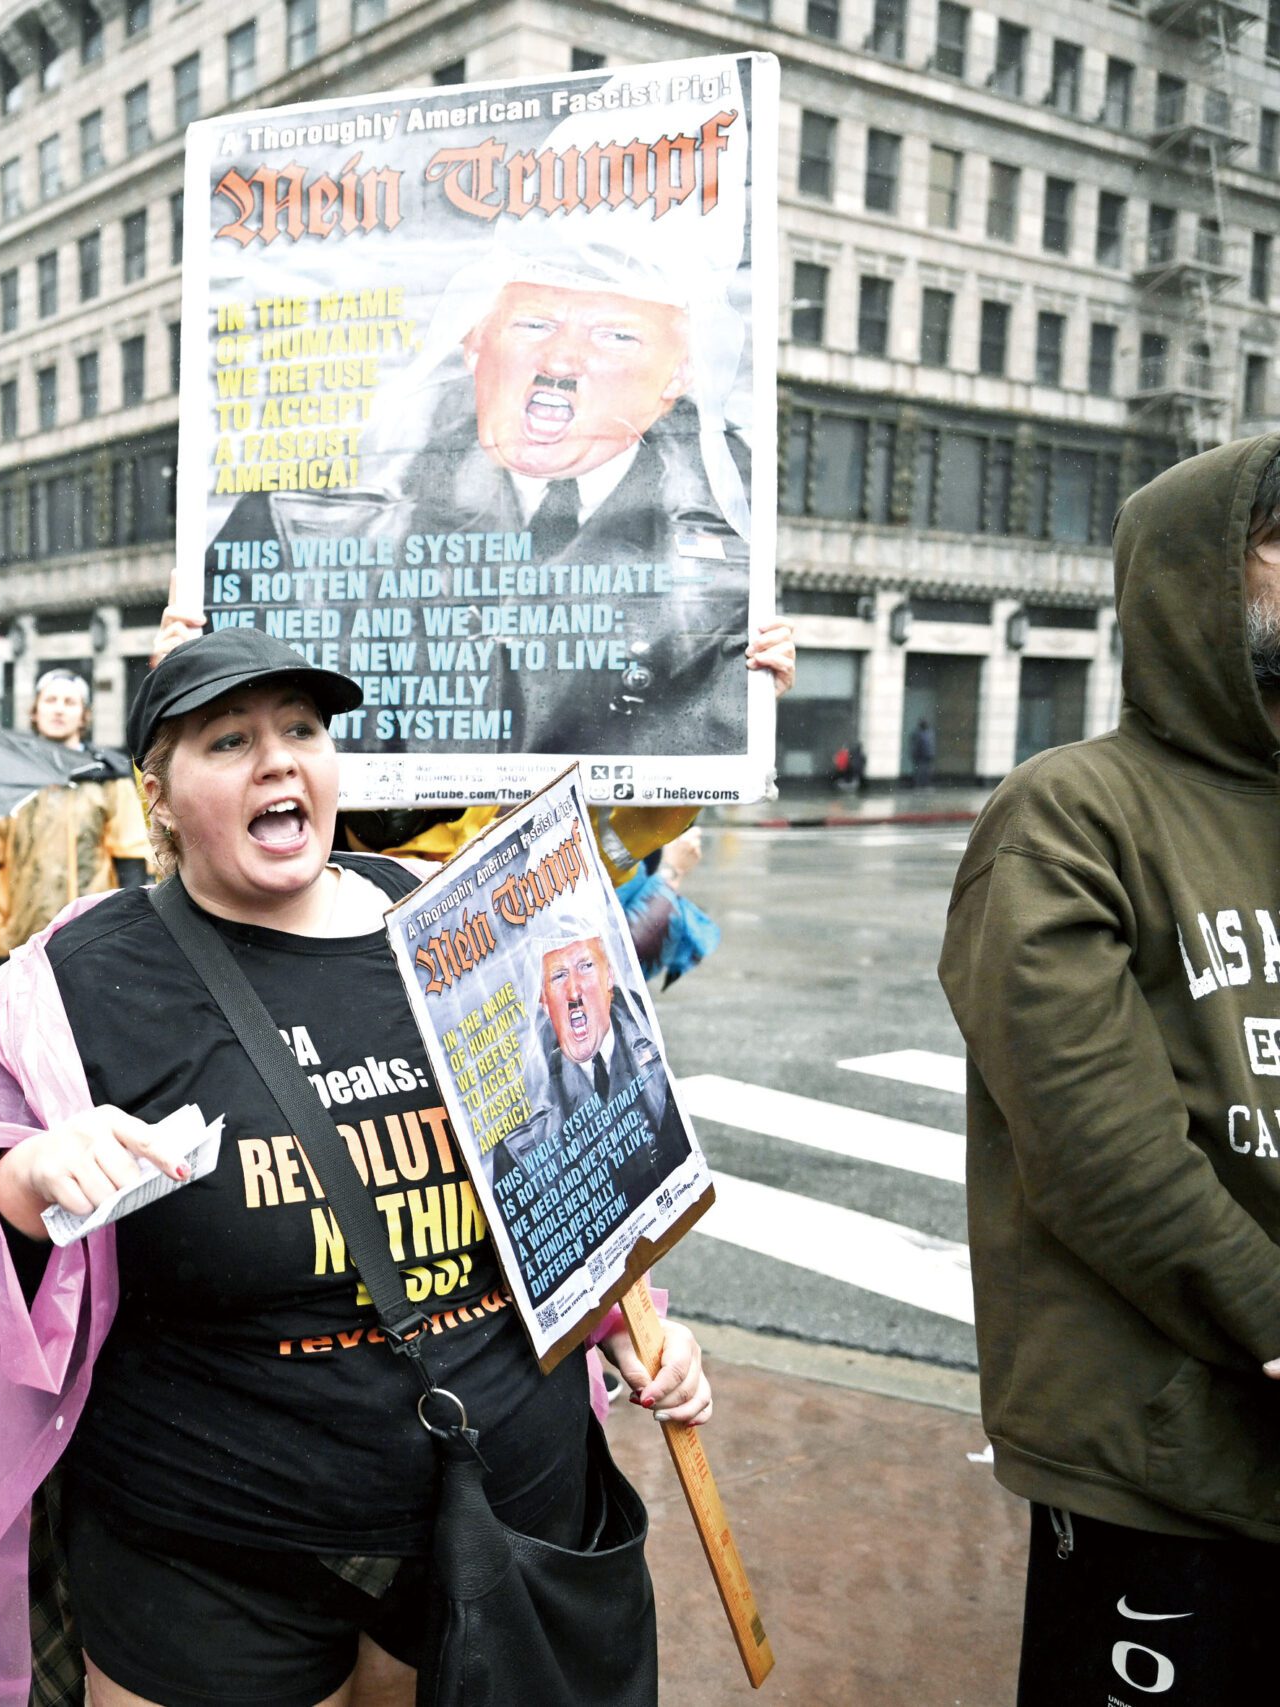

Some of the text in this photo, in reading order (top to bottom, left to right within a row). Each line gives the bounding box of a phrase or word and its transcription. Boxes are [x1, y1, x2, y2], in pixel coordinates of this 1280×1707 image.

[221, 73, 732, 155] A Thoroughly American Fascist Pig!
[213, 109, 738, 248] Mein Trumpf
[217, 287, 405, 332] IN THE NAME
[216, 320, 425, 365] OF HUMANITY,
[216, 357, 380, 398] WE REFUSE
[215, 393, 376, 432] TO ACCEPT
[214, 427, 363, 465] A FASCIST
[216, 457, 359, 494] AMERICA!
[213, 531, 532, 570] THIS WHOLE SYSTEM
[212, 573, 241, 603] IS
[250, 571, 368, 602] ROTTEN
[377, 567, 442, 599] AND
[210, 604, 624, 638] WE NEED AND WE DEMAND:
[289, 640, 638, 674] OLE NEW WAY TO LIVE,
[358, 675, 491, 706] ENTALLY
[376, 709, 513, 740] SYSTEM!
[642, 787, 740, 800] @TheRevcoms
[408, 796, 574, 939] A Thoroughly American Fascist Pig!
[415, 816, 589, 996] Mein Trumpf
[1176, 909, 1252, 1001] LOS
[442, 981, 518, 1053] IN THE NAME
[307, 1056, 429, 1109] peaks:
[449, 1047, 466, 1074] OF
[456, 1030, 520, 1094] WE REFUSE
[463, 1052, 525, 1114] TO ACCEPT
[471, 1075, 528, 1136] A FASCIST
[478, 1096, 533, 1156] AMERICA!
[493, 1091, 604, 1201] THIS WHOLE SYSTEM
[509, 1109, 642, 1242] WE NEED AND WE DEMAND:
[501, 1199, 517, 1221] IS
[516, 1160, 560, 1207] ROTTEN
[560, 1138, 581, 1169] AND
[517, 1240, 529, 1262] A
[527, 1206, 566, 1250] WHOLE
[563, 1186, 589, 1217] NEW
[587, 1162, 611, 1193] WAY
[610, 1149, 625, 1170] TO
[524, 1259, 535, 1280] A
[534, 1180, 616, 1270] FUNDAMENTALLY
[530, 1237, 584, 1299] DIFFERENT
[586, 1191, 629, 1245] SYSTEM!
